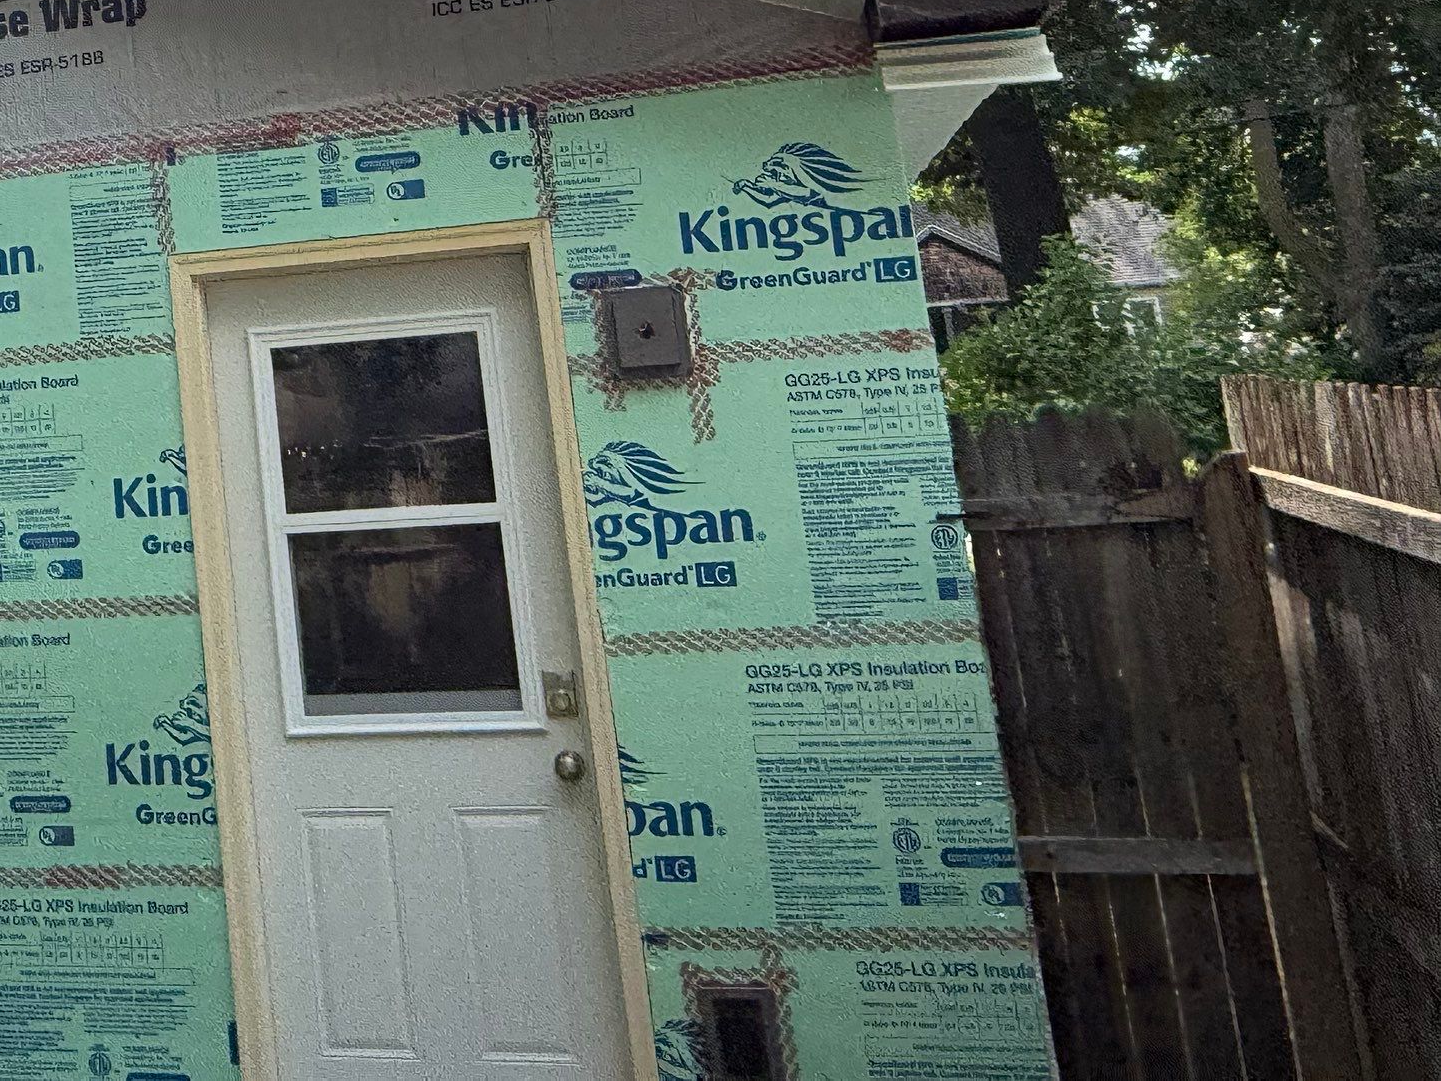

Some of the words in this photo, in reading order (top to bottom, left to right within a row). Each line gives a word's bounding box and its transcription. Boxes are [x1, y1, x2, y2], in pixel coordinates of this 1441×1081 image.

[431, 0, 462, 17] ICC
[590, 104, 634, 120] Board
[716, 267, 869, 291] GreenGuard
[875, 257, 917, 282] LG
[41, 374, 79, 388] Board
[865, 367, 901, 383] XPS
[787, 389, 822, 402] ASTM
[864, 386, 892, 399] Type
[696, 562, 736, 587] LG
[826, 662, 863, 677] XPS
[868, 660, 950, 677] Insulation
[748, 682, 783, 694] ASTM
[656, 856, 697, 882] LG
[46, 899, 73, 913] XPS
[78, 899, 144, 914] Insulation
[147, 900, 189, 915] Board
[942, 961, 979, 978] XPS
